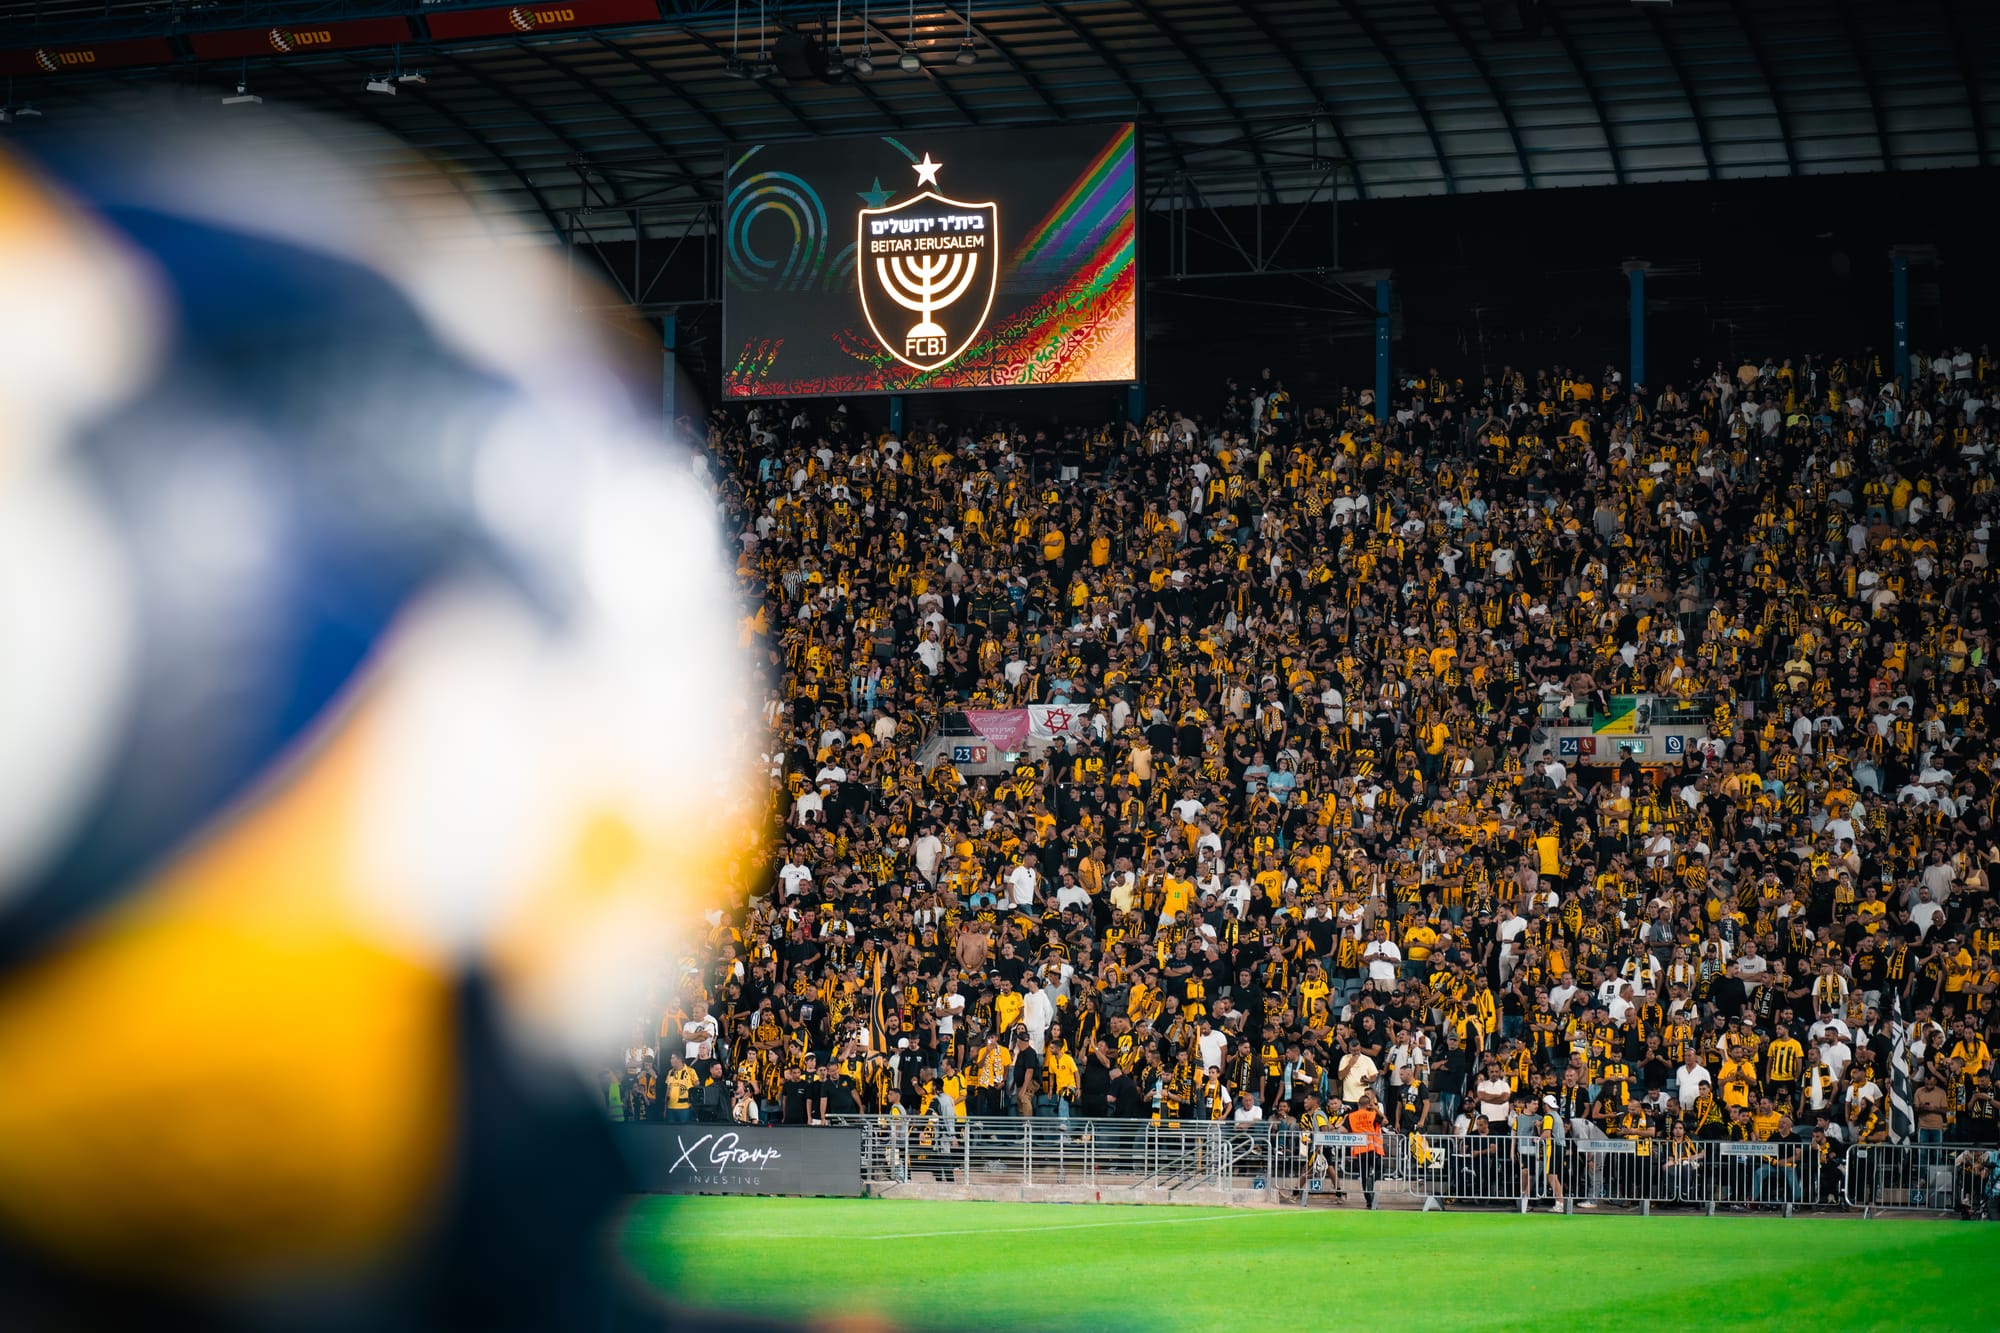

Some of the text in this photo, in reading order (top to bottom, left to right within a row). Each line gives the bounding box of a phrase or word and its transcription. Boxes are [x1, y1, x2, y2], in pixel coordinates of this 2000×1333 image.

[534, 8, 575, 24] טוטו
[293, 31, 332, 46] טוטו
[59, 50, 96, 65] טוטו
[871, 218, 934, 235] ירושלים
[871, 235, 984, 253] BEITAR JERUSALEM
[906, 337, 947, 357] FCBJ
[1561, 739, 1578, 753] 24
[955, 748, 970, 761] 23
[791, 780, 800, 793] 10
[669, 1132, 782, 1174] X Group
[689, 1175, 761, 1186] INVESTING
